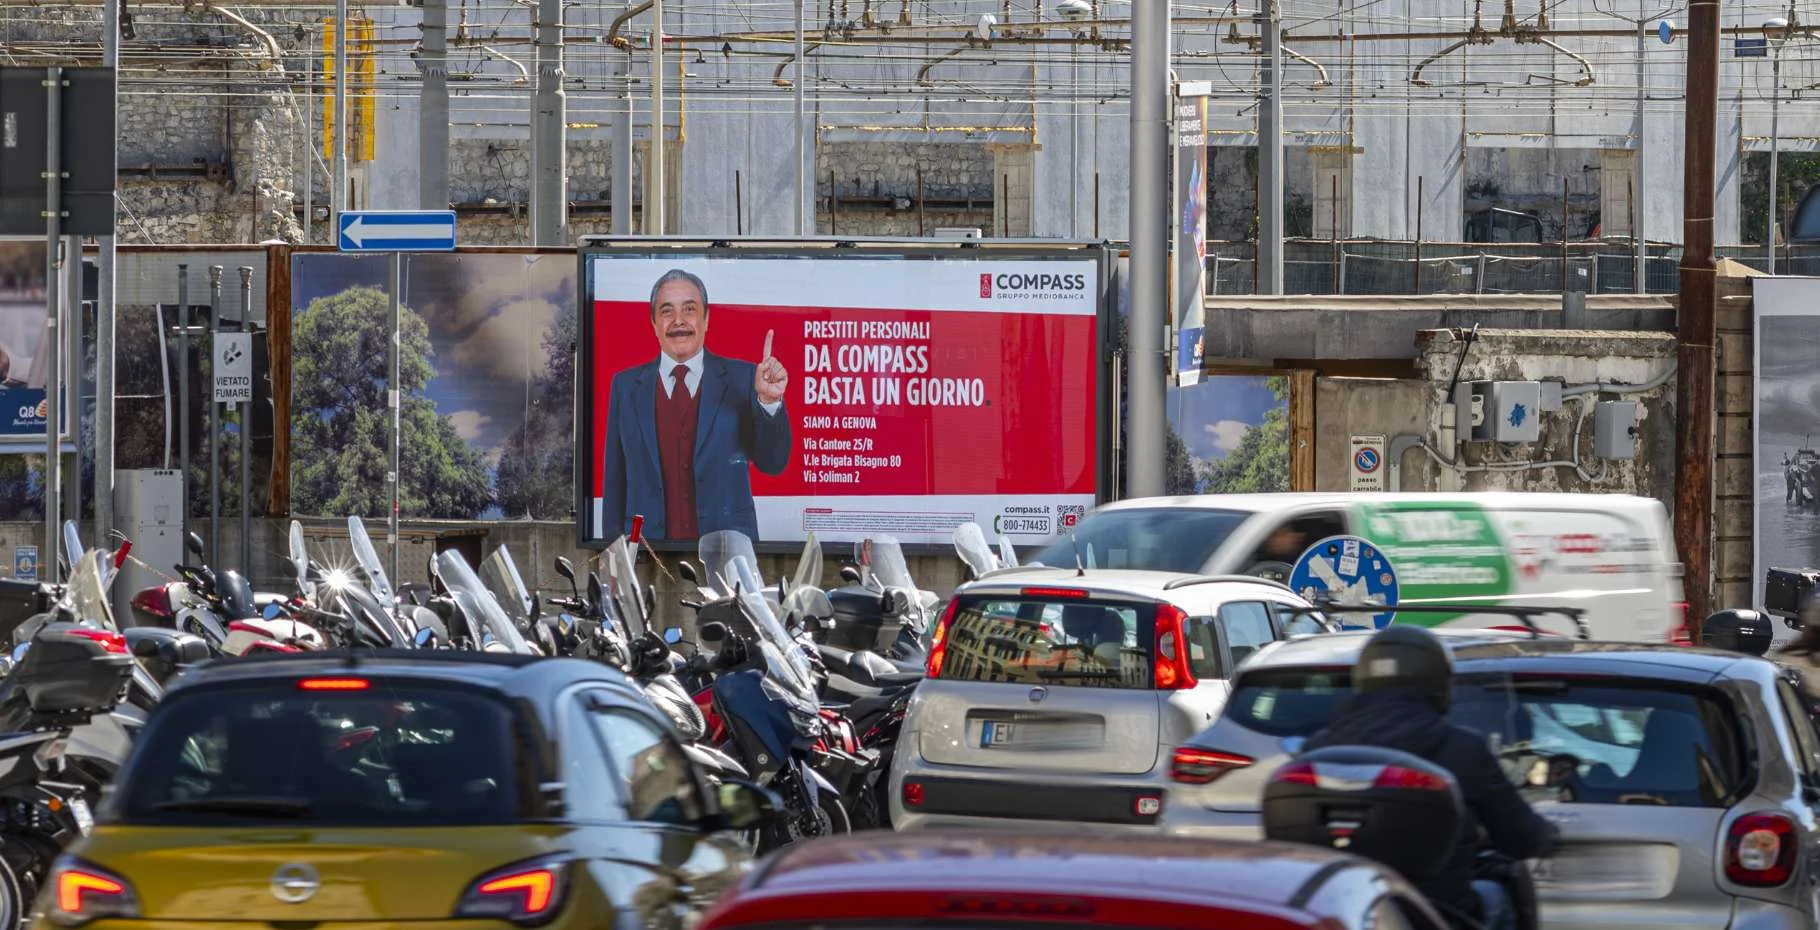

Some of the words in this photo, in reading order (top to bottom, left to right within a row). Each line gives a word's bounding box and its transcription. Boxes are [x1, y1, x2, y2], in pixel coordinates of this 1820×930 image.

[996, 274, 1085, 290] COMPASS
[804, 320, 858, 338] PRESTITI
[861, 321, 930, 339] PERSONALI
[804, 344, 832, 373] DA
[837, 345, 929, 374] COMPASS
[216, 376, 249, 386] VIETATO
[215, 388, 249, 398] FUMARE
[804, 376, 866, 405] BASTA
[872, 377, 901, 406] UN
[19, 406, 35, 418] Q8
[803, 416, 831, 429] SIAMO
[833, 416, 840, 429] A
[841, 416, 877, 430] GENOVA
[803, 437, 817, 450] Via
[818, 437, 852, 451] Cantore
[852, 437, 873, 452] 25/R
[803, 453, 820, 467] V.le
[821, 454, 853, 469] Brigata
[854, 454, 888, 469] Bisagno
[889, 455, 902, 468] 80
[803, 470, 817, 483] Via
[818, 470, 853, 484] Soliman
[854, 471, 861, 484] 2
[1004, 505, 1050, 515] compass.it
[1003, 519, 1048, 532] 800-774433
